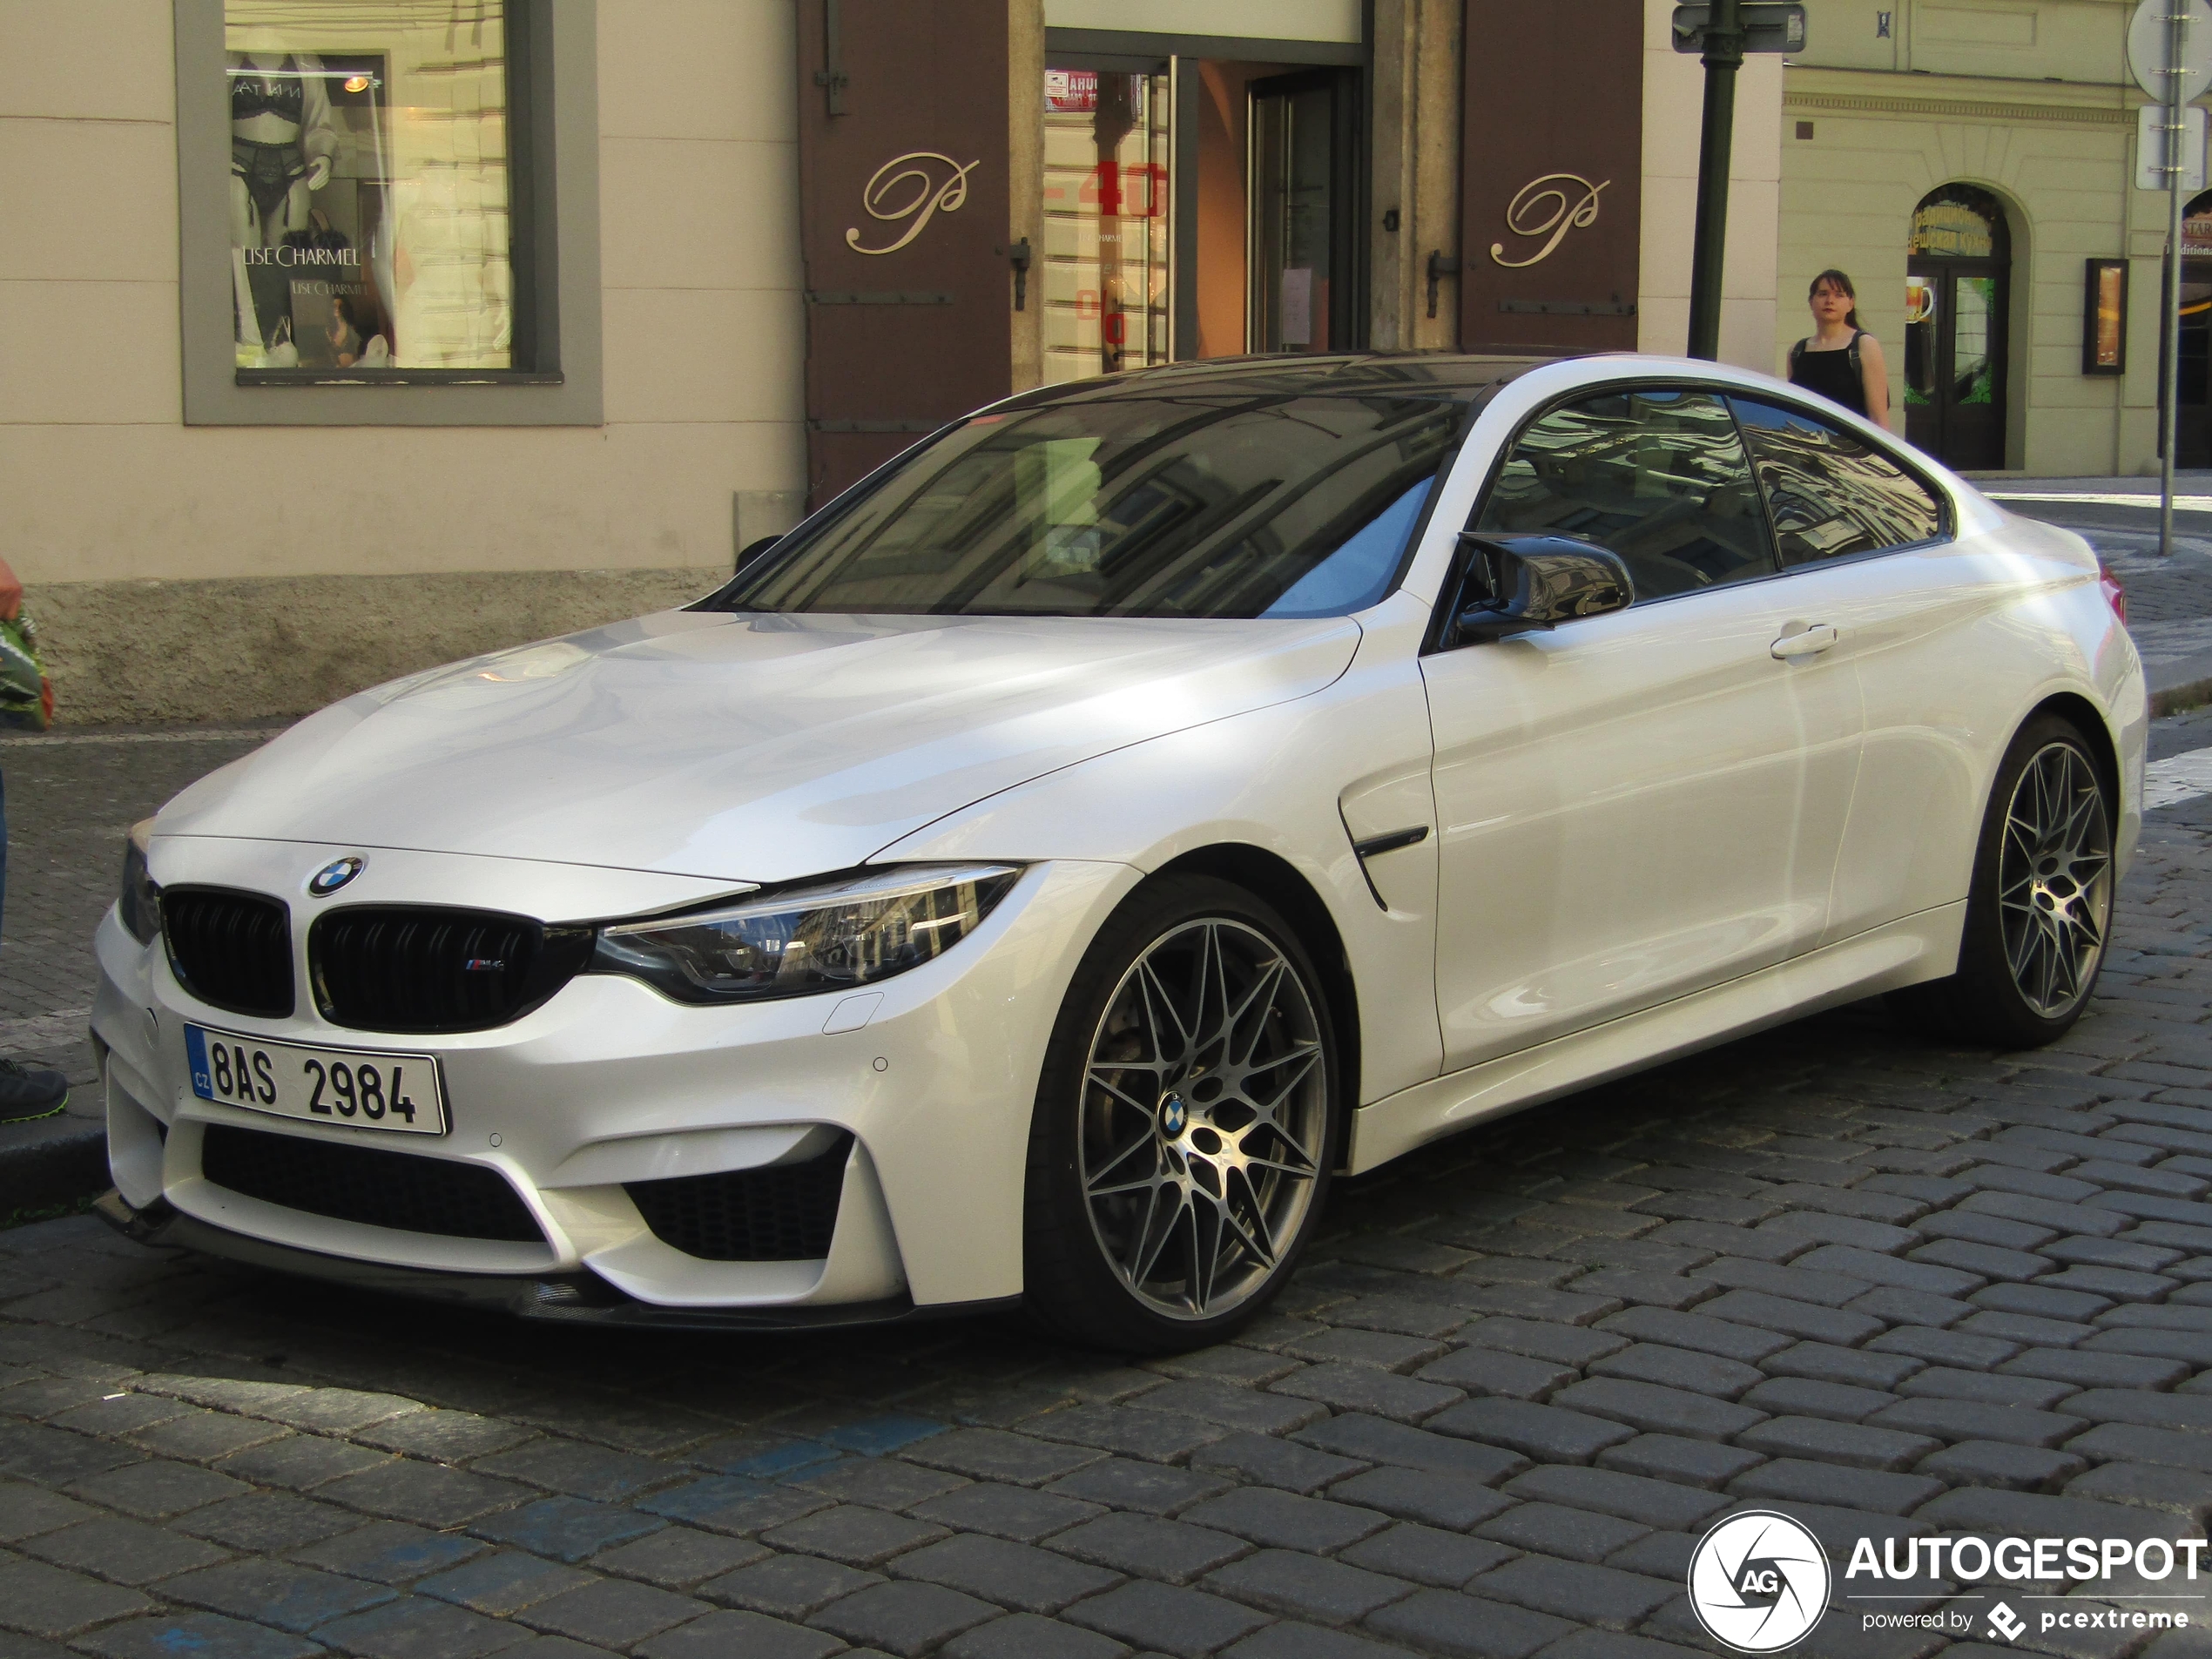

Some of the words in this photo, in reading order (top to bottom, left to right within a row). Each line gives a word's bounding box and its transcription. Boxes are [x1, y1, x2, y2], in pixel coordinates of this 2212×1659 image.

[846, 152, 980, 254] P
[1490, 173, 1611, 267] P
[243, 246, 273, 266] LISE
[276, 245, 361, 267] CHARMEL
[195, 1072, 211, 1089] CZ
[212, 1042, 277, 1104] 8AS
[304, 1058, 416, 1123] 2984
